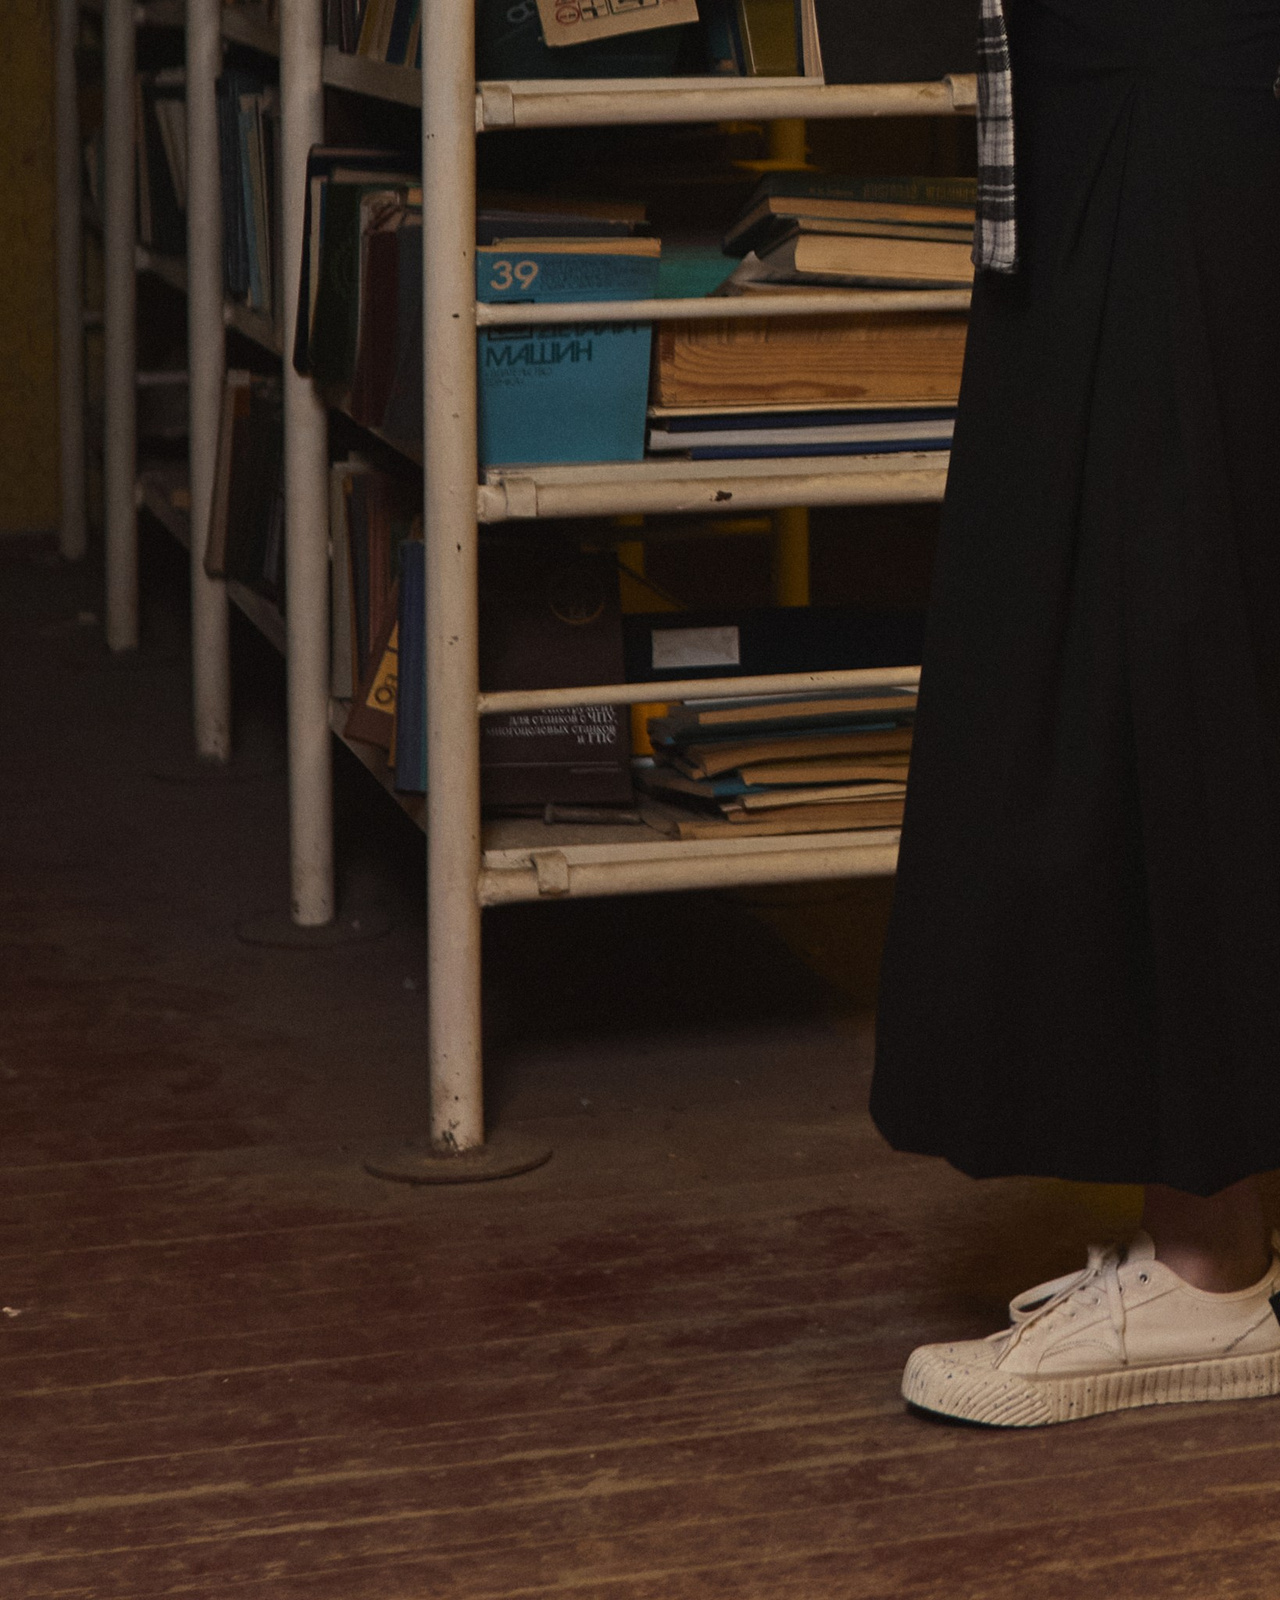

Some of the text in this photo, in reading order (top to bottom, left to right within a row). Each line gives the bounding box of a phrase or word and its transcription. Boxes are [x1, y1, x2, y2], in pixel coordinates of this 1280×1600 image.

[490, 260, 539, 291] 39
[485, 338, 593, 367] МАШИН
[532, 714, 578, 725] станков
[572, 724, 616, 735] станков
